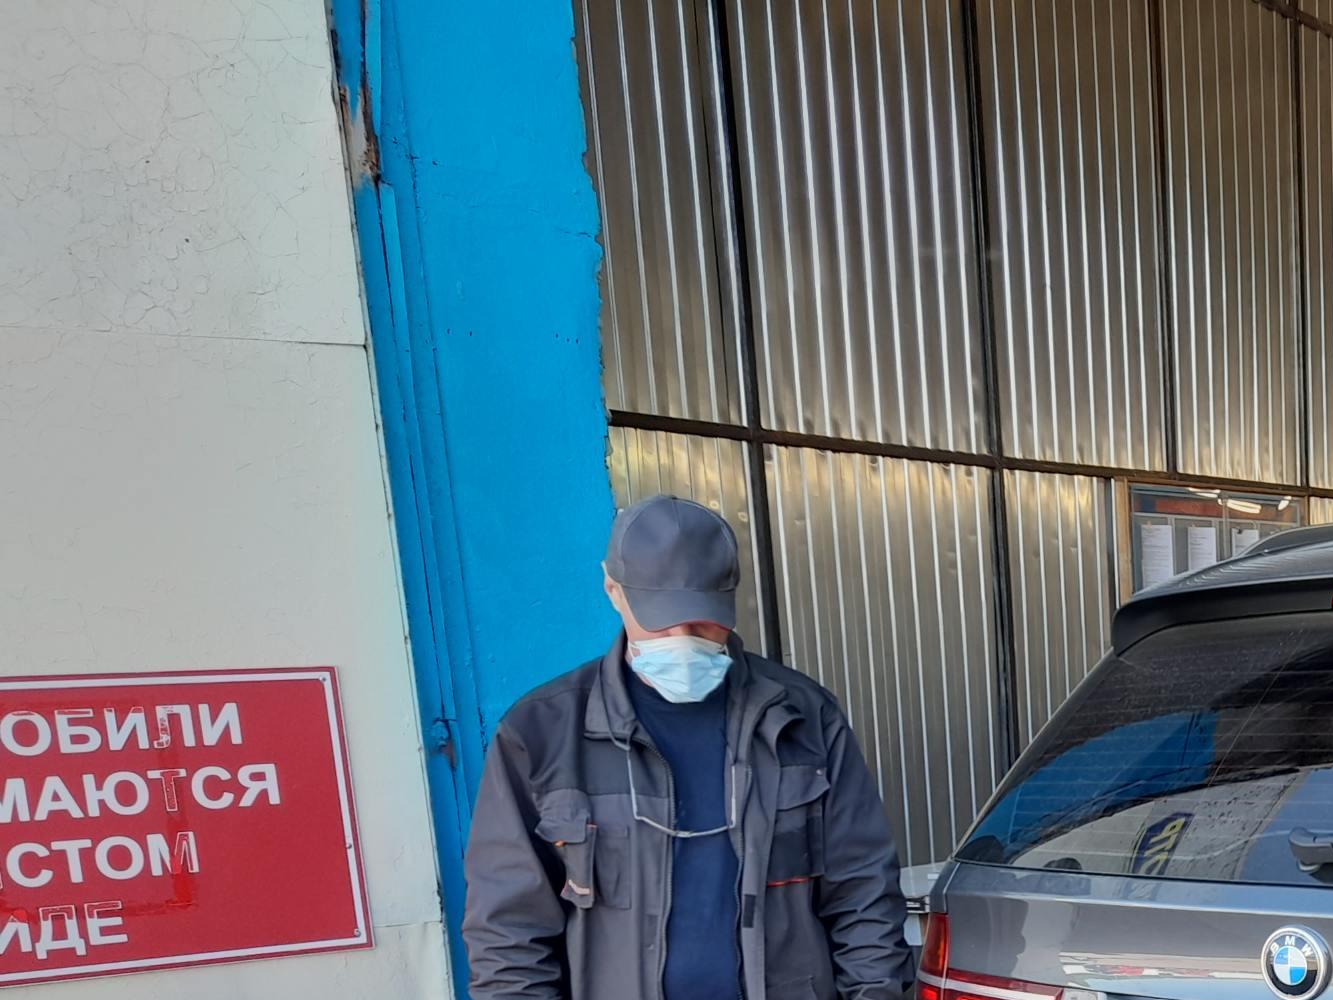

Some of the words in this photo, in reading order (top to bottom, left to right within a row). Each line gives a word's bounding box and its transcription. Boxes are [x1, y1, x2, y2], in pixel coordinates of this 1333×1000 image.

[0, 703, 243, 756] ОБИЛИ
[0, 831, 200, 889] СТОМ
[1269, 935, 1314, 957] BMW
